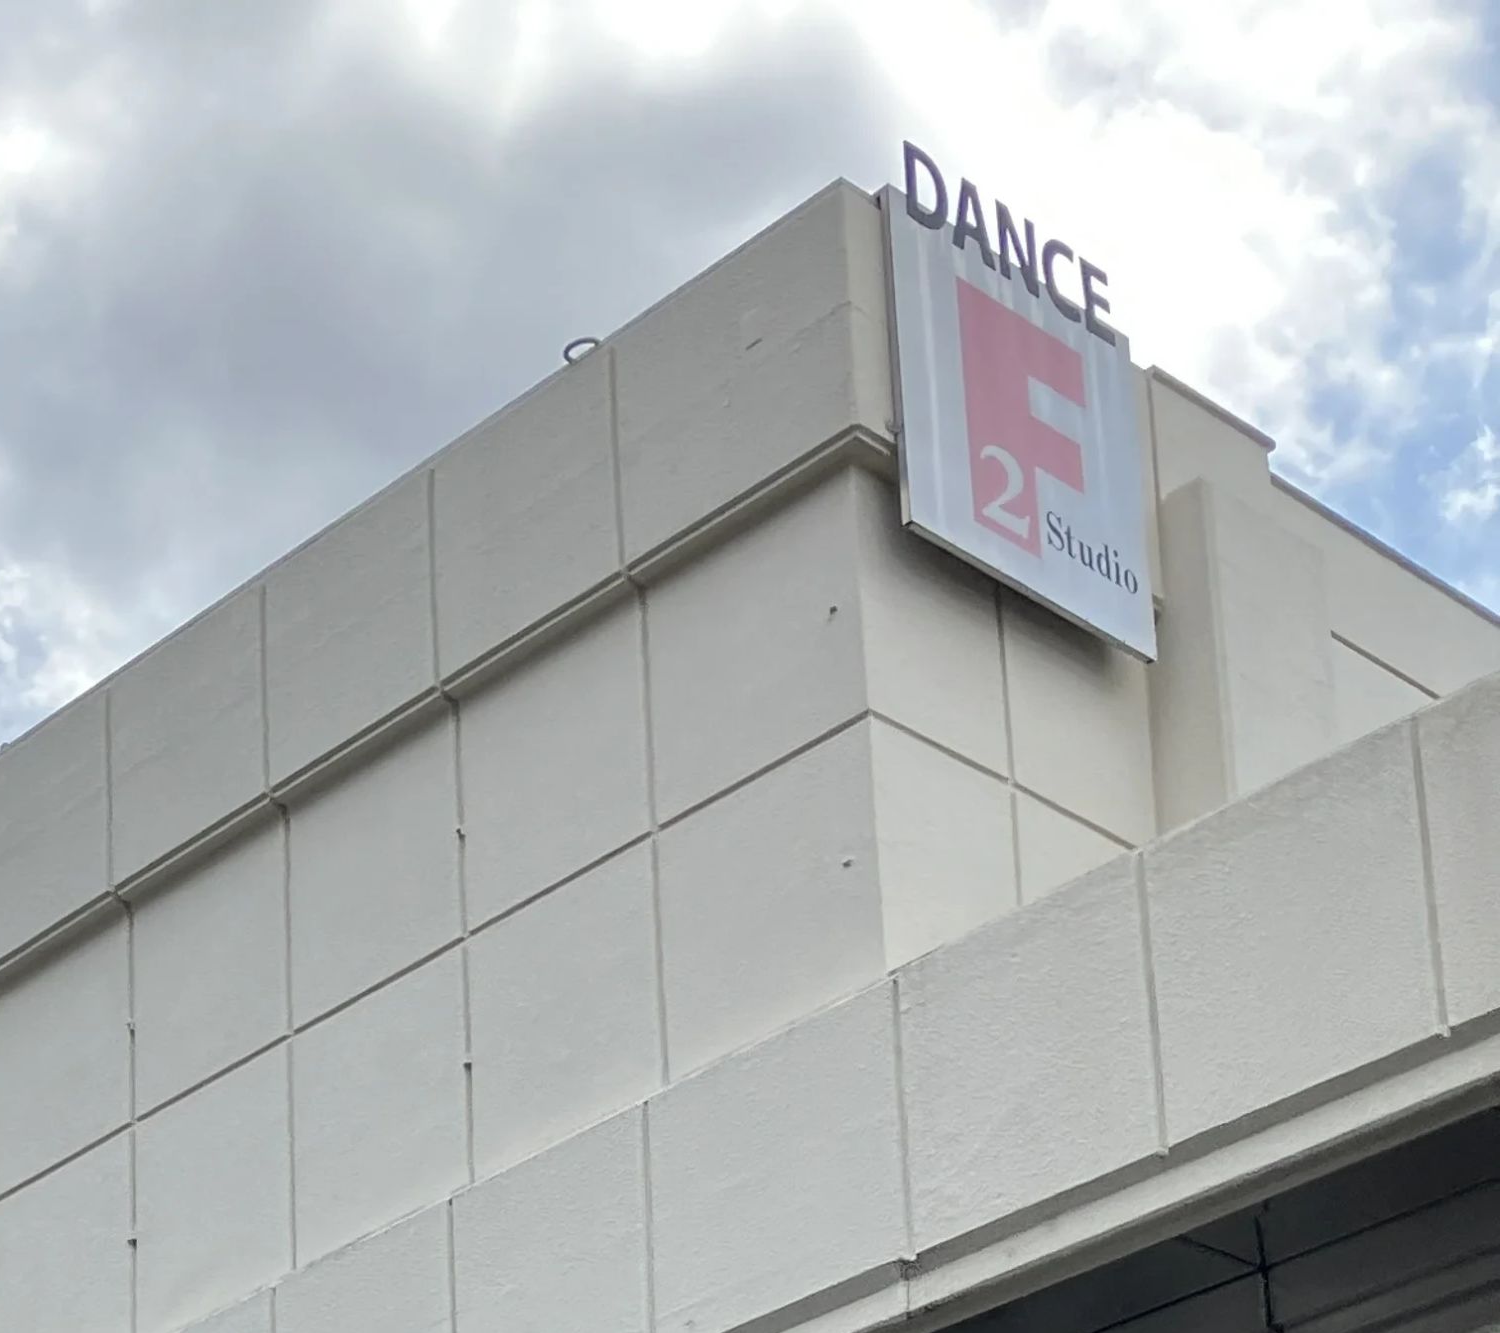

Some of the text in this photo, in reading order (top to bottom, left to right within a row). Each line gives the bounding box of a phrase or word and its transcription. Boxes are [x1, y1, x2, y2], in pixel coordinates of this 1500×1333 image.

[903, 140, 1116, 347] DANCE
[979, 445, 1139, 596] 2 Studio
